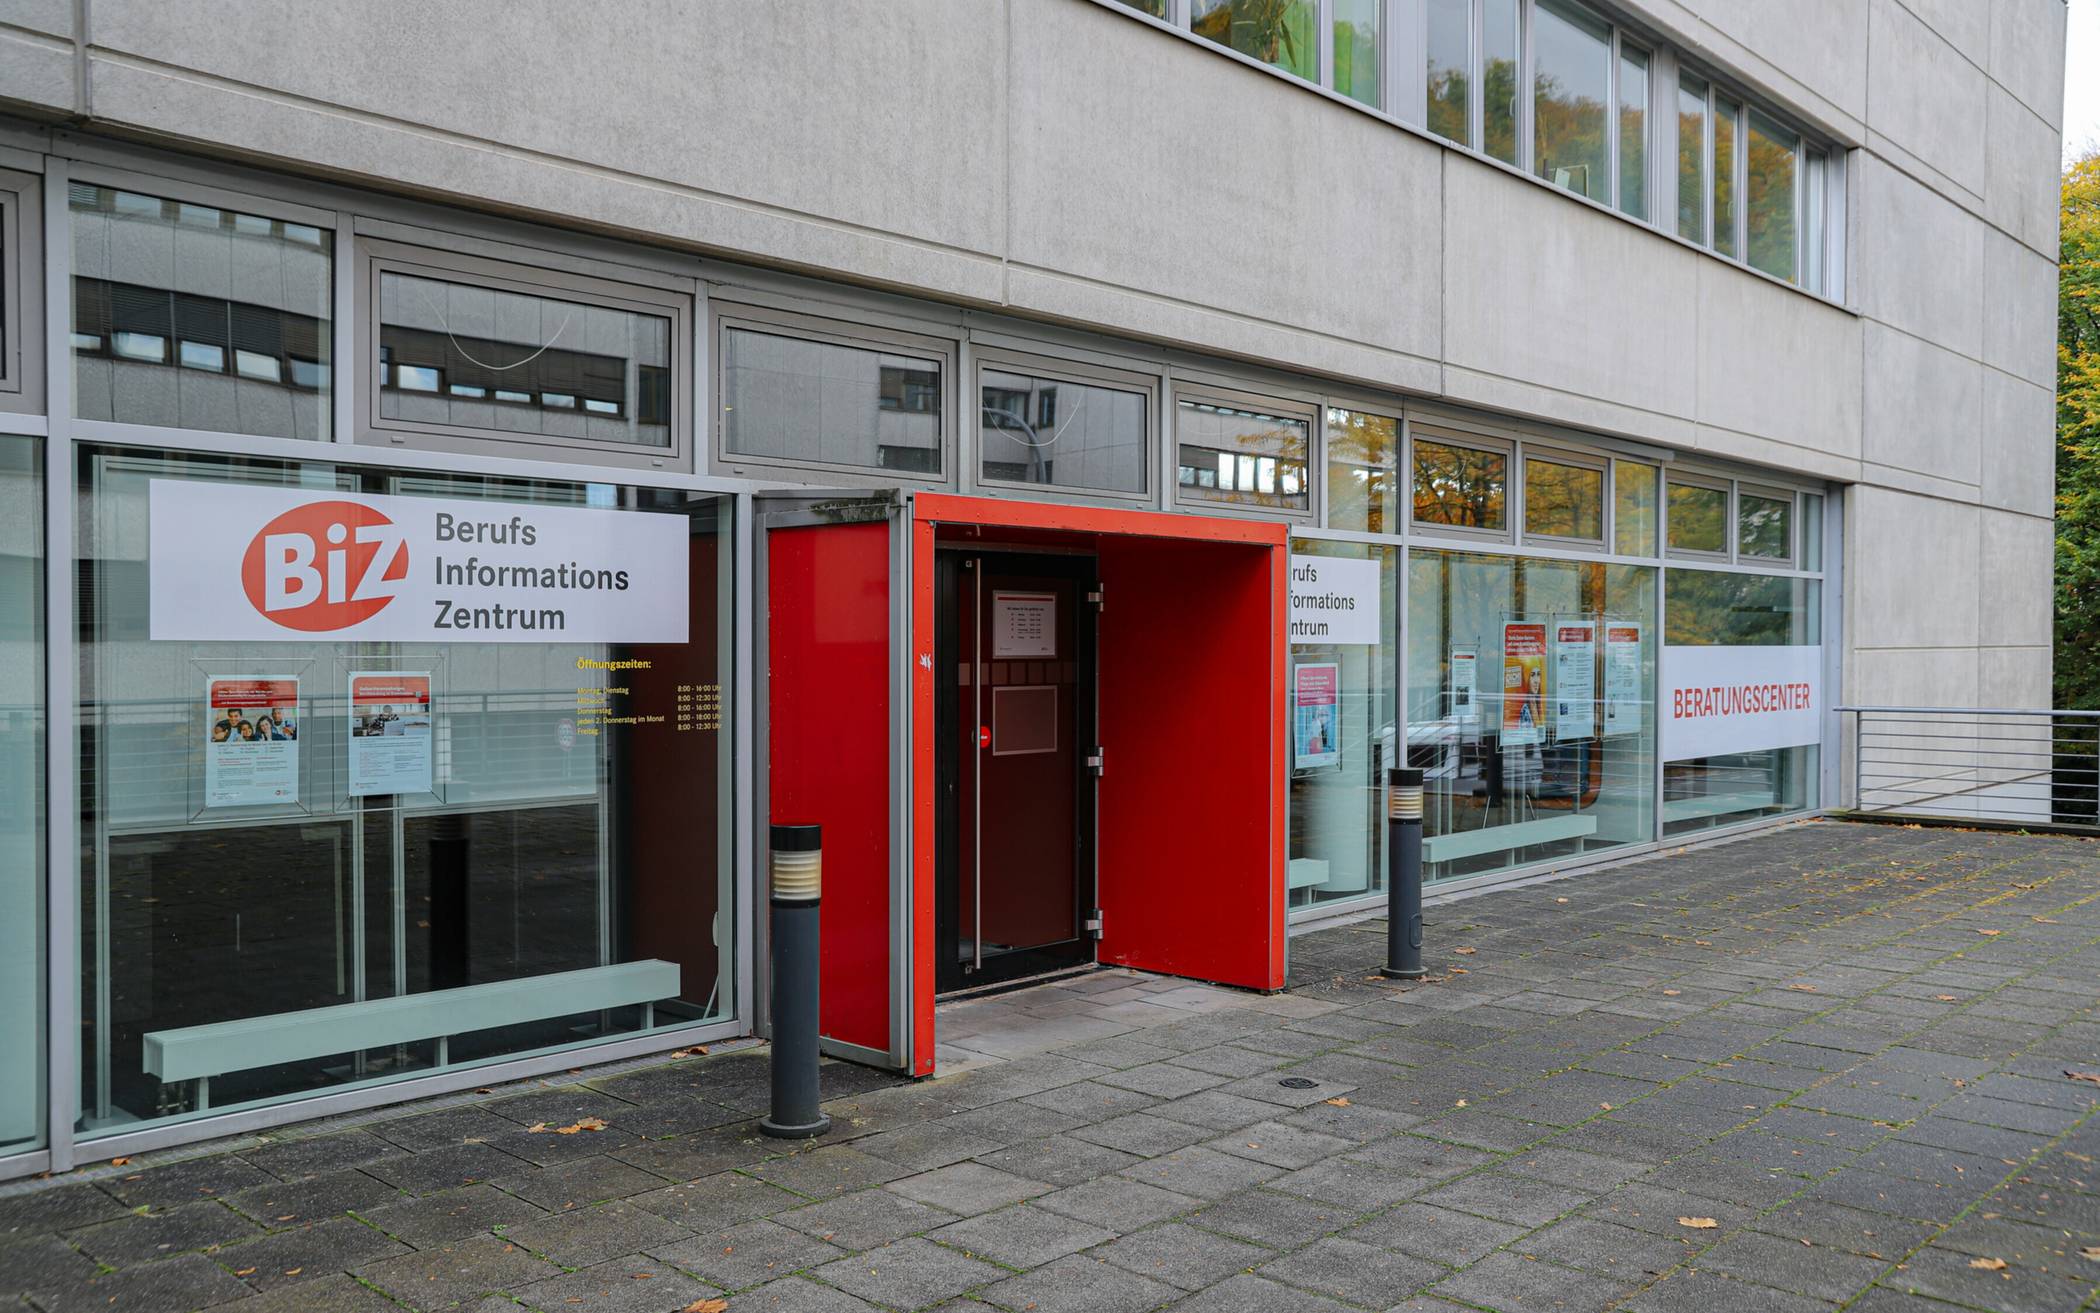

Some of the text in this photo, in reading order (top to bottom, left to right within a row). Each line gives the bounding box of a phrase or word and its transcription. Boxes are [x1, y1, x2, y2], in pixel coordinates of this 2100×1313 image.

[436, 513, 537, 547] Berufs
[265, 523, 408, 612] BiZ
[436, 556, 629, 591] Informations
[434, 599, 565, 630] Zentrum
[1291, 590, 1355, 610] ormations
[576, 657, 652, 671] Öffnungszeiten:
[603, 687, 629, 695] Dienstag
[1674, 683, 1810, 719] BERATUNGSCENTER
[603, 716, 637, 724] Donnerstag
